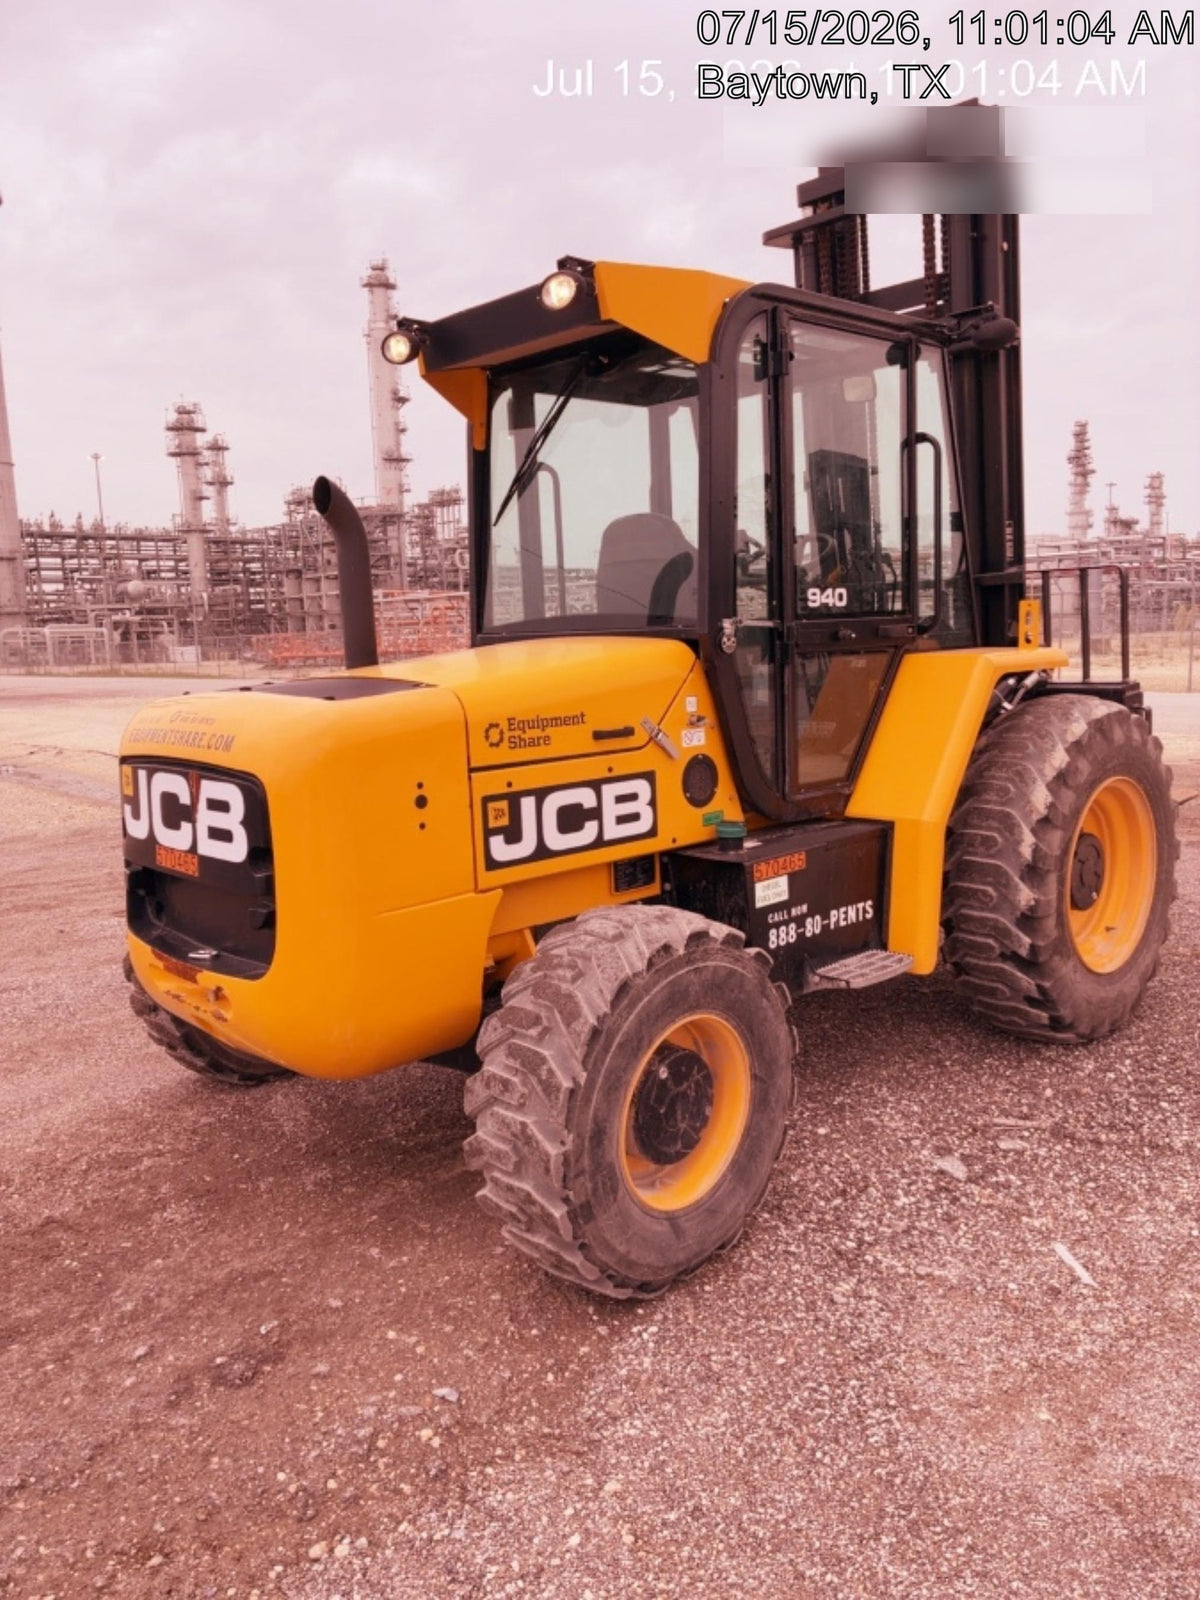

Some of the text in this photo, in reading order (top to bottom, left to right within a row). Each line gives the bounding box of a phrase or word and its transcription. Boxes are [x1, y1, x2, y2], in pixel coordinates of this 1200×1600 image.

[806, 587, 847, 608] 940
[507, 711, 586, 733] Equipment
[508, 734, 551, 750] Share
[123, 768, 249, 863] JCB
[488, 778, 654, 862] JCB
[754, 851, 805, 881] 570465
[768, 903, 808, 924] CALL NOW
[768, 899, 874, 949] 888-80-PENTS
